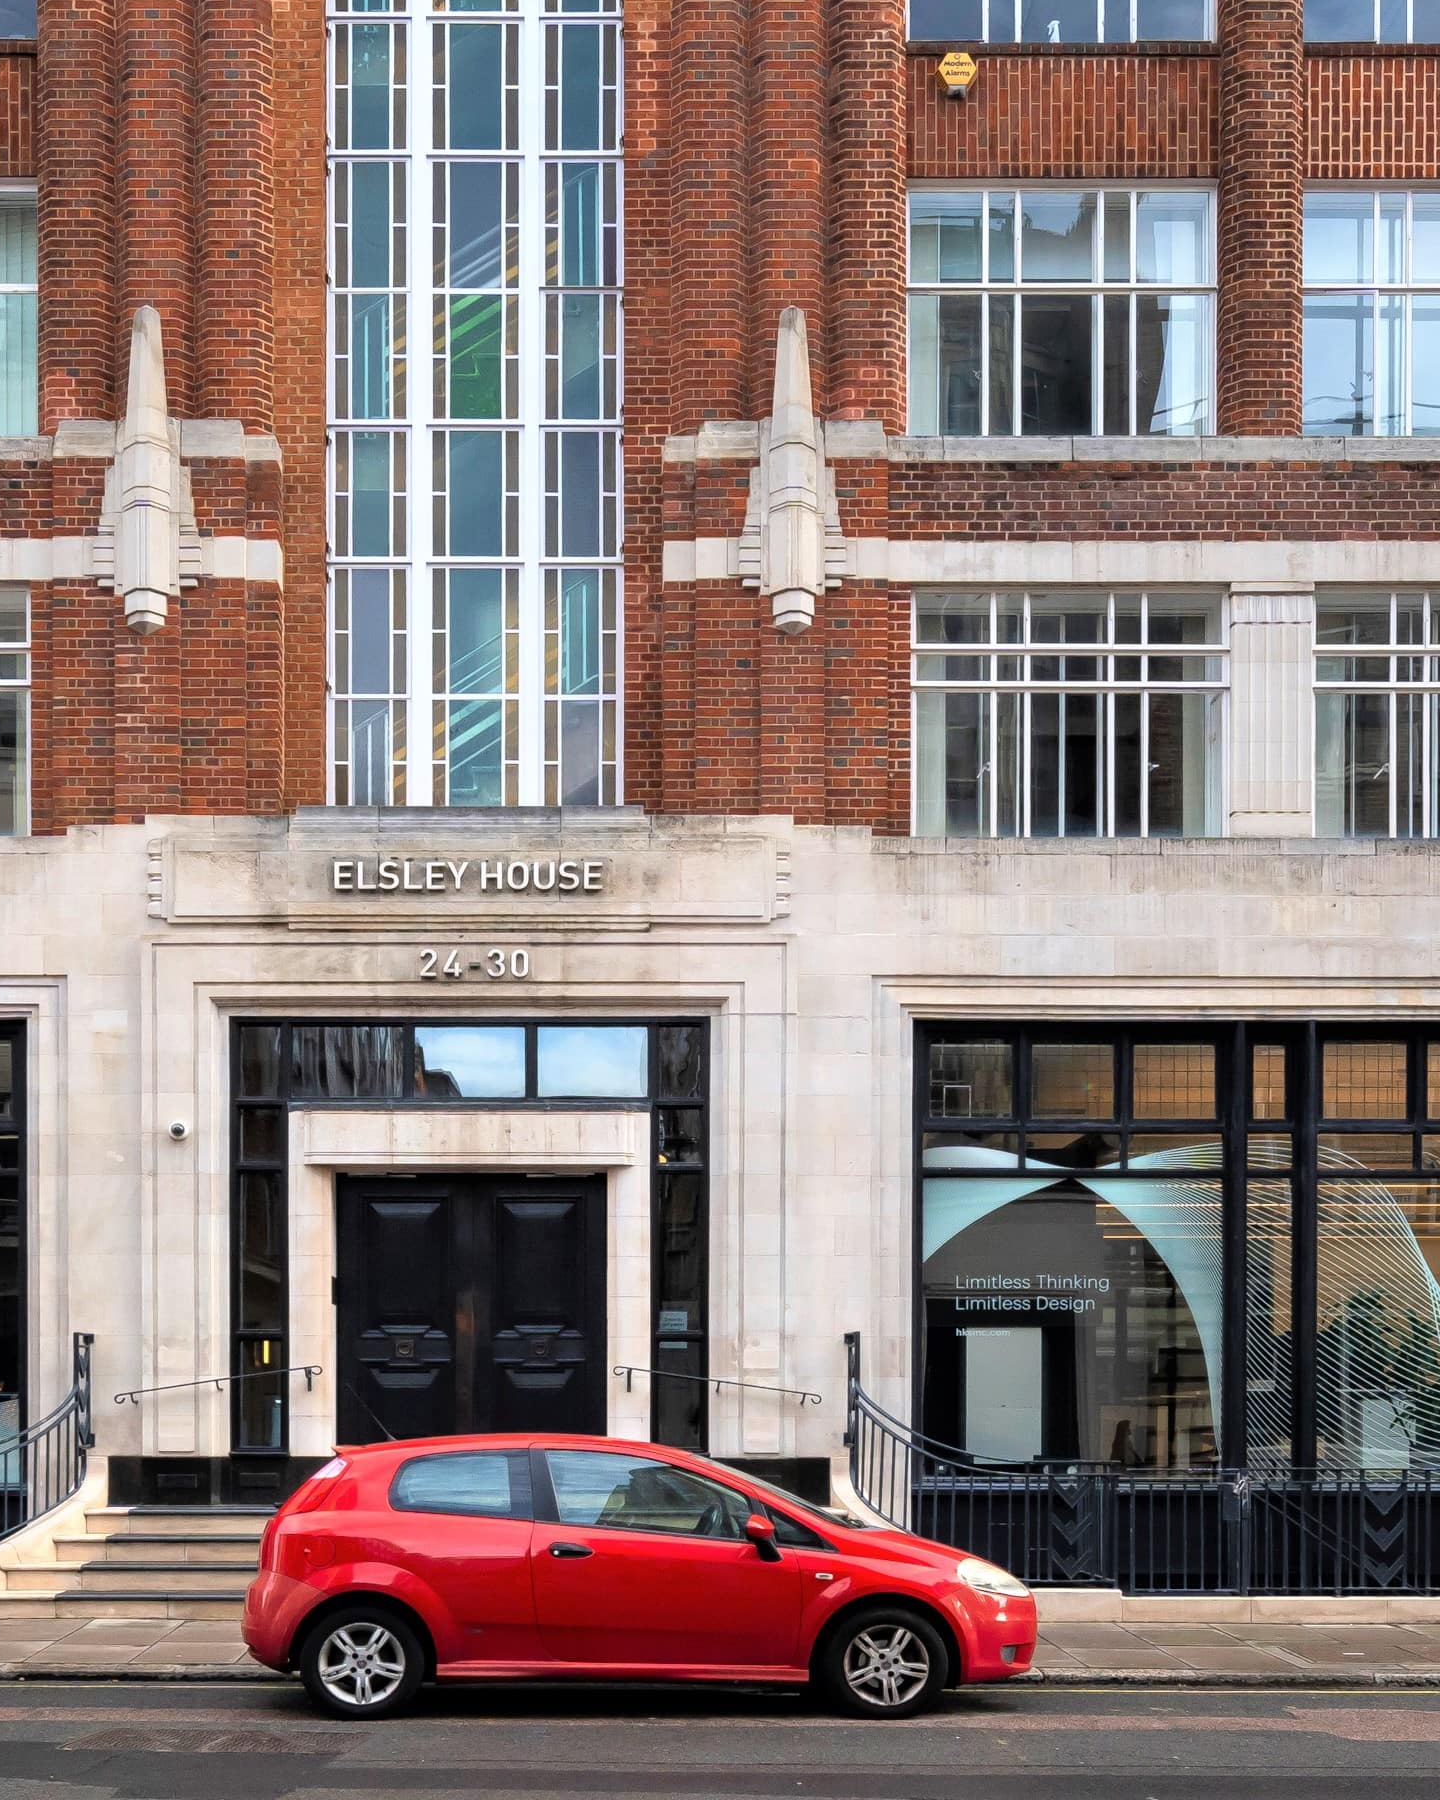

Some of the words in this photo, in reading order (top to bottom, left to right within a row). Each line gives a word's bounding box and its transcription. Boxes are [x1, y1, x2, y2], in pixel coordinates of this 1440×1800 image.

[333, 861, 469, 890] ELSLEY
[480, 861, 603, 890] HOUSE
[419, 949, 530, 978] 24-30
[955, 1274, 1031, 1289] Limitless
[1036, 1274, 1110, 1292] Thinking
[955, 1295, 1031, 1311] Limitless
[1036, 1296, 1096, 1313] Design
